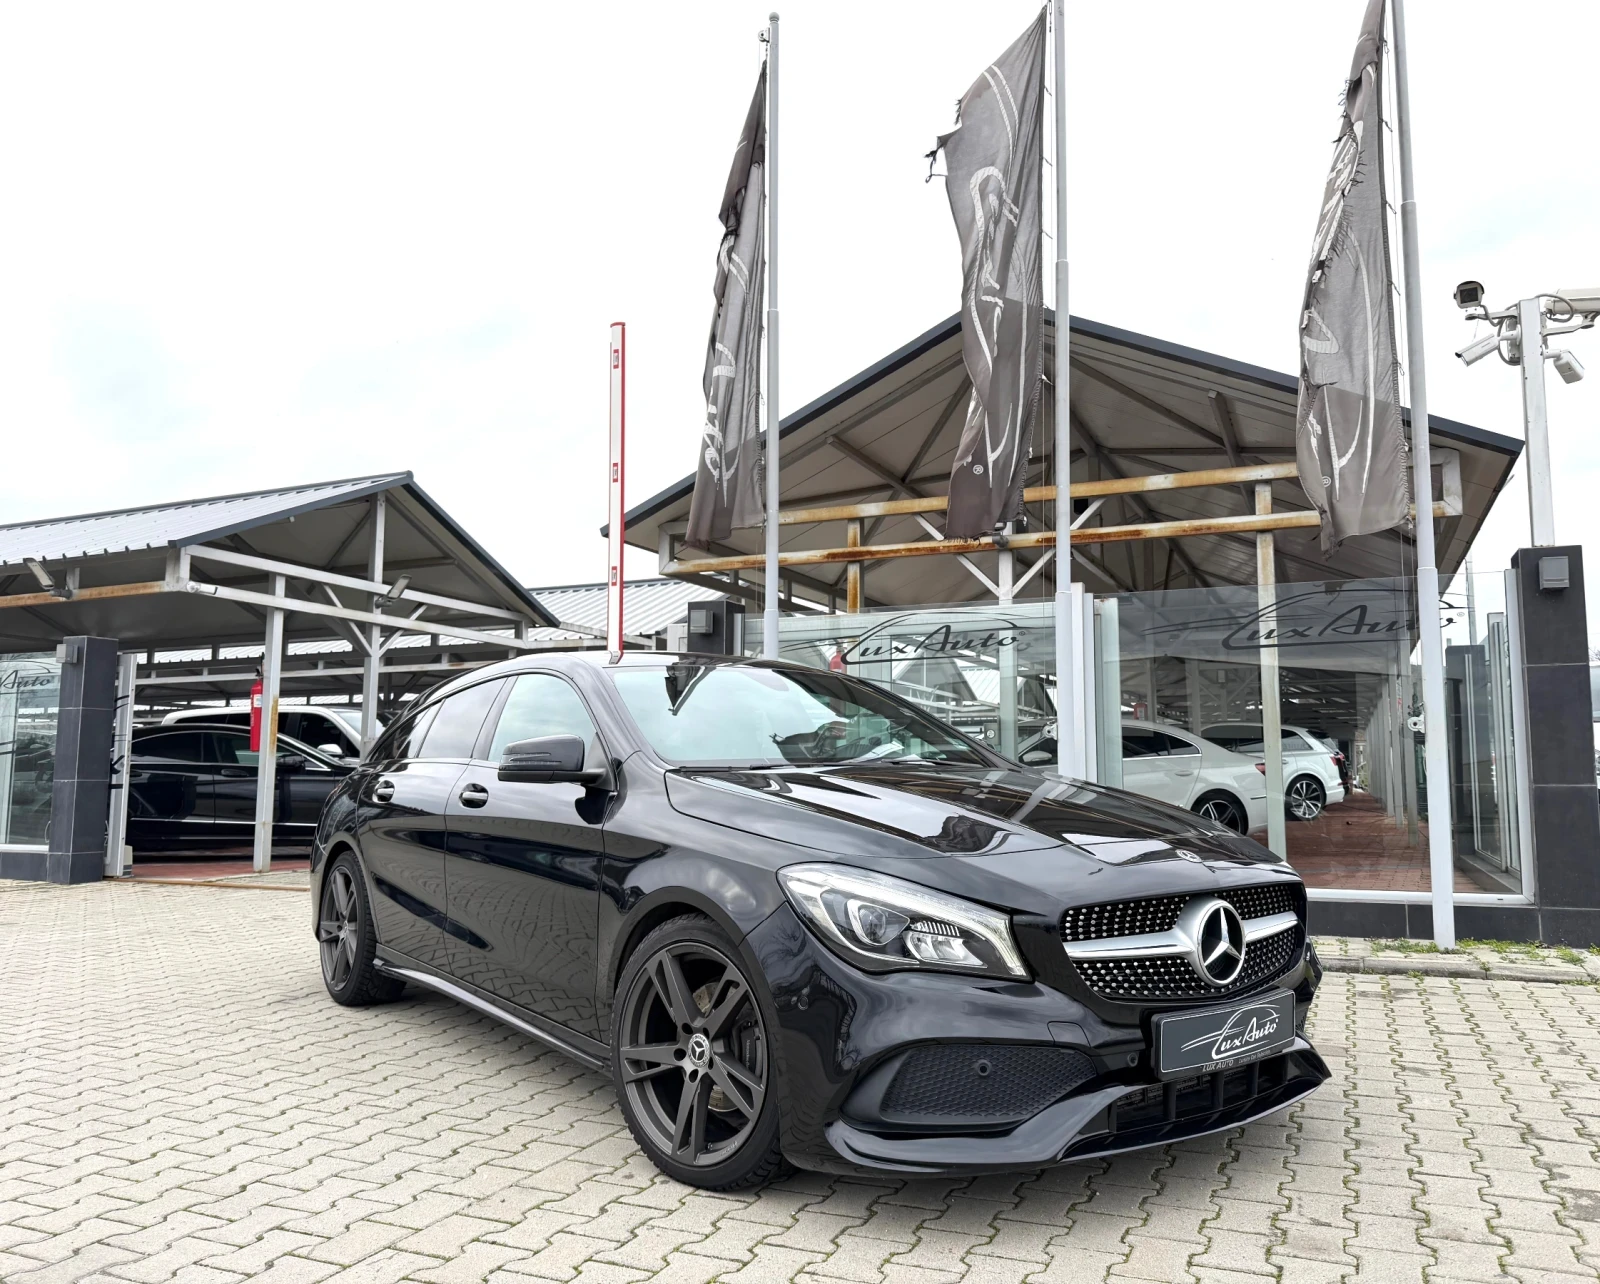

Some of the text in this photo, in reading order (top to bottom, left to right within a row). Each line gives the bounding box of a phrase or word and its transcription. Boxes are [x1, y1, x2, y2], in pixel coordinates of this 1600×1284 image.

[0, 669, 50, 689] Auto
[1202, 1060, 1234, 1072] LUX AUTO
